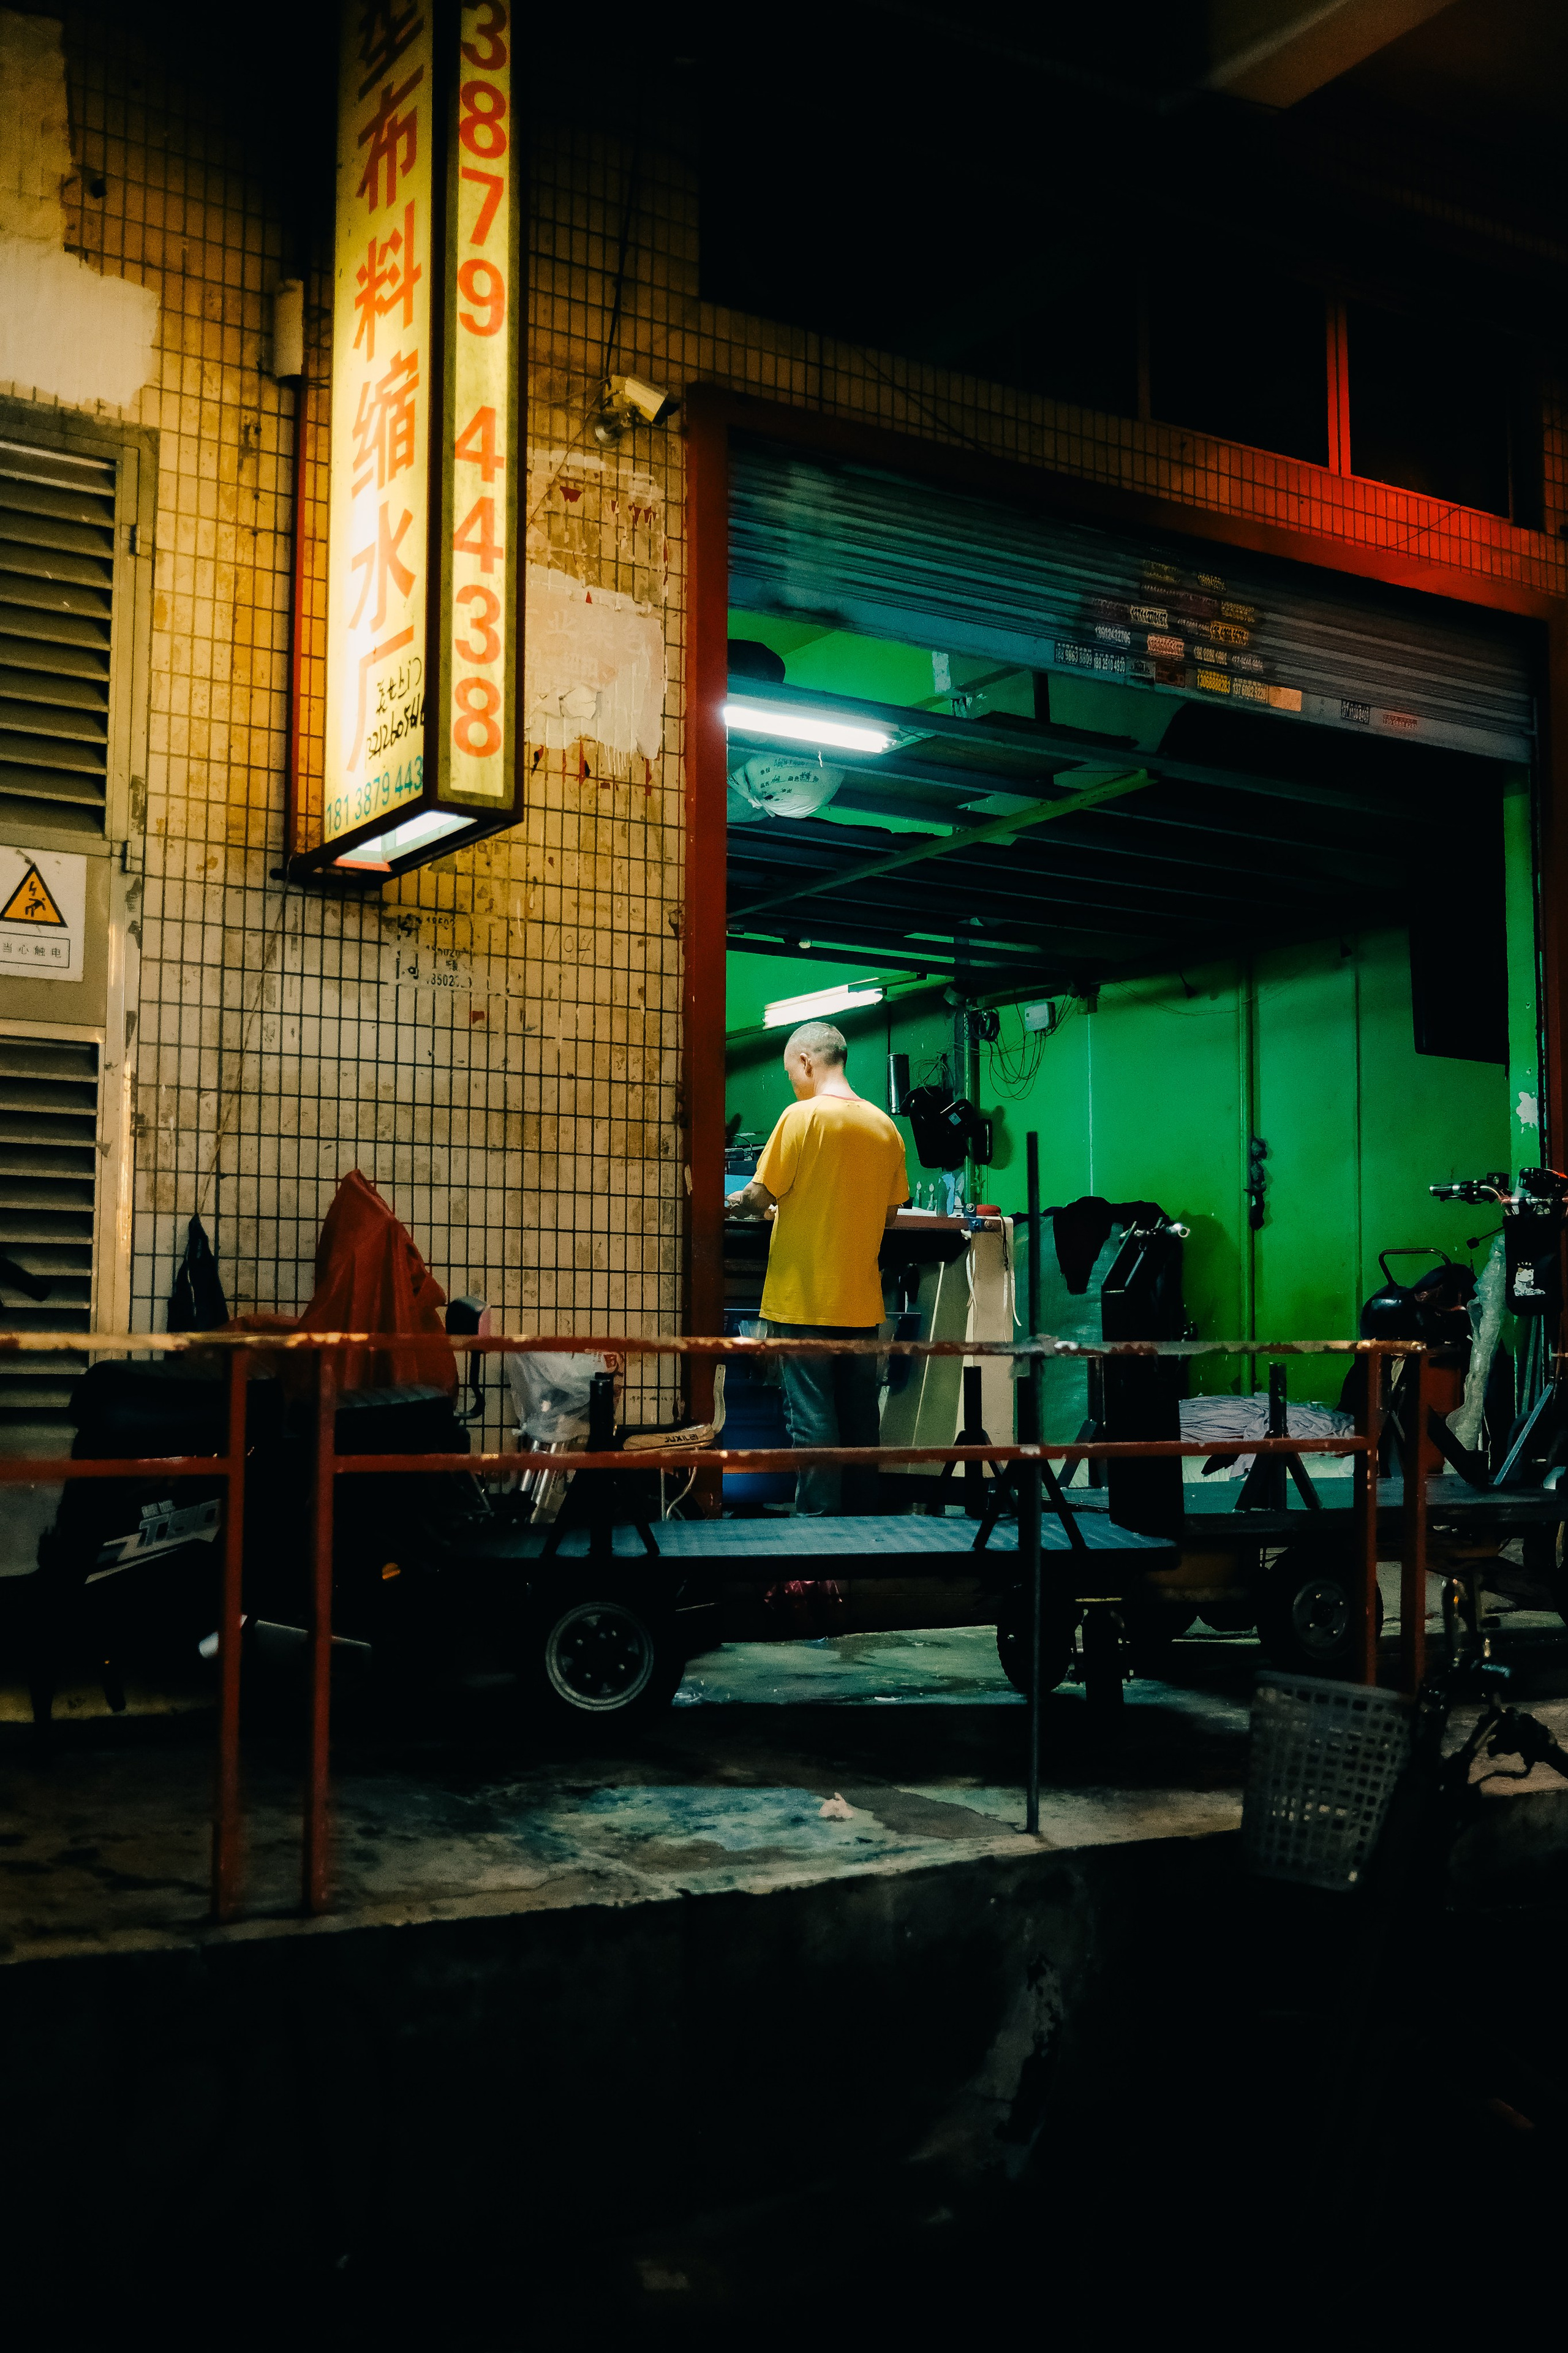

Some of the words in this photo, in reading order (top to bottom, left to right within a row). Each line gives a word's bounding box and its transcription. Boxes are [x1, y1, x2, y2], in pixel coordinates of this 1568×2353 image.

[452, 406, 506, 758] 4438
[2, 942, 61, 959] 当心触电
